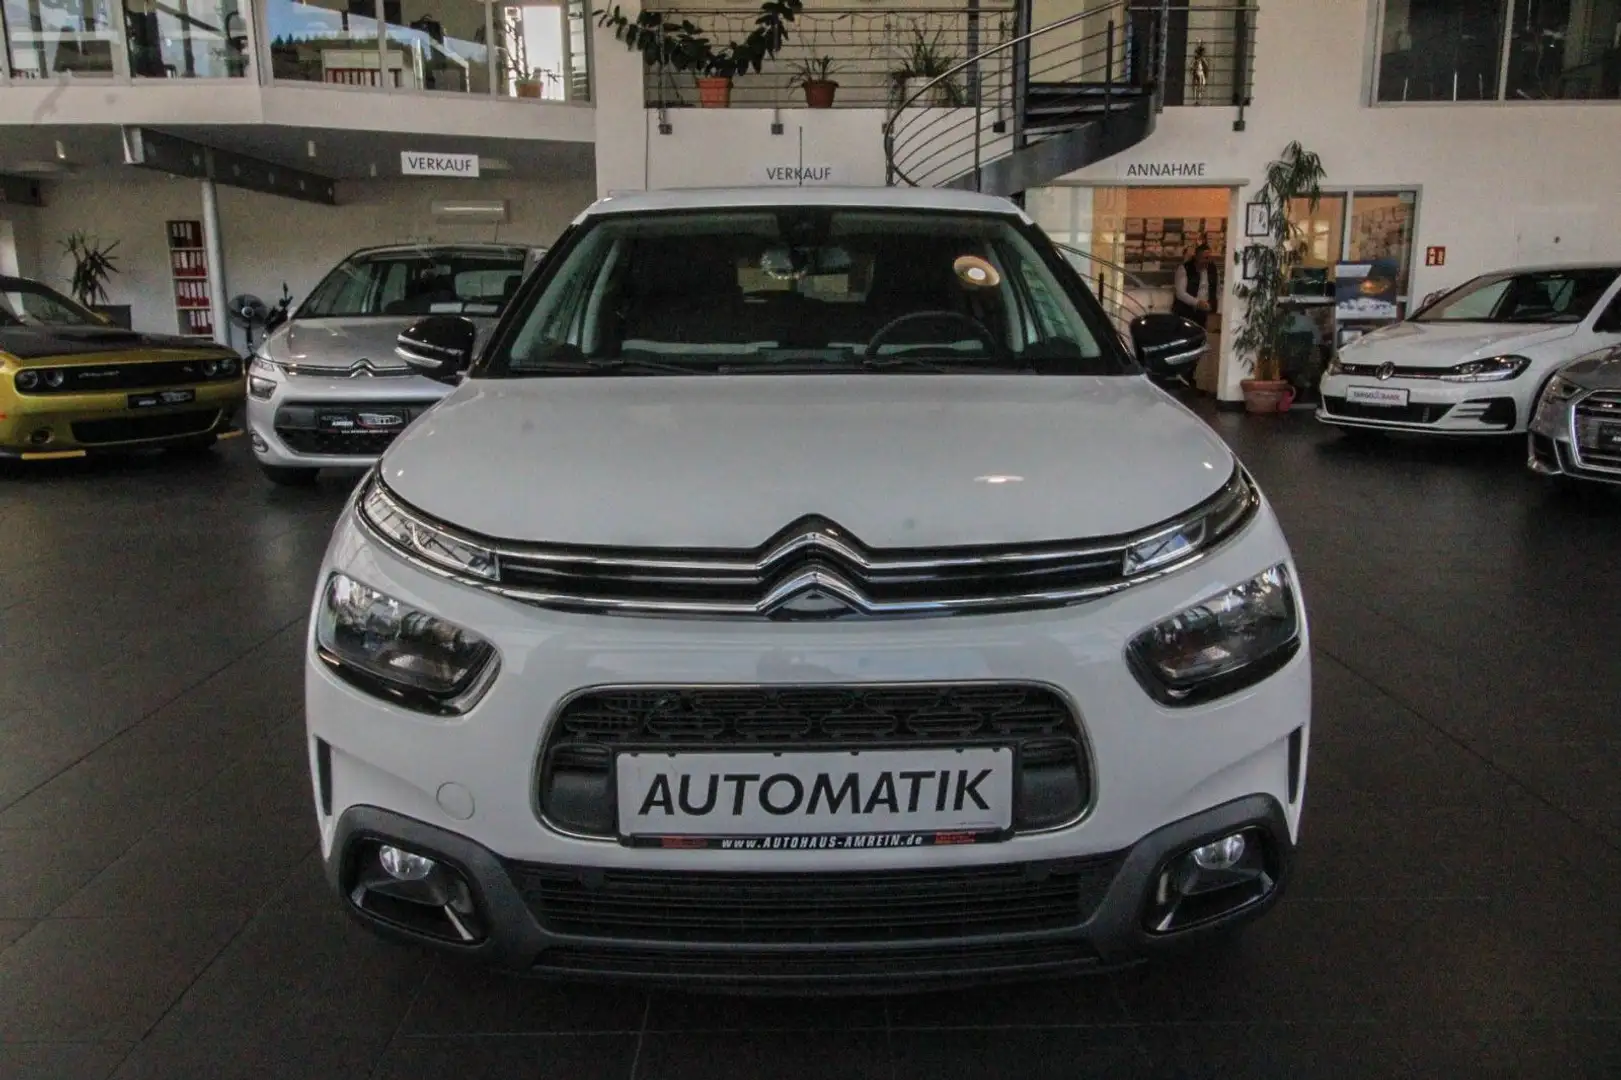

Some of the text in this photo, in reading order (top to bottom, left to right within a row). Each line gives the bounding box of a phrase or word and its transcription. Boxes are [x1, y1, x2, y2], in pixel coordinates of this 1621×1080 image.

[408, 156, 472, 171] VERKAUF
[1127, 163, 1205, 177] ANNAHME
[766, 167, 832, 181] VERKAUF
[638, 769, 994, 816] AUTOMATIK
[722, 834, 923, 849] www.AUTOHAUS-AMREIN.de
